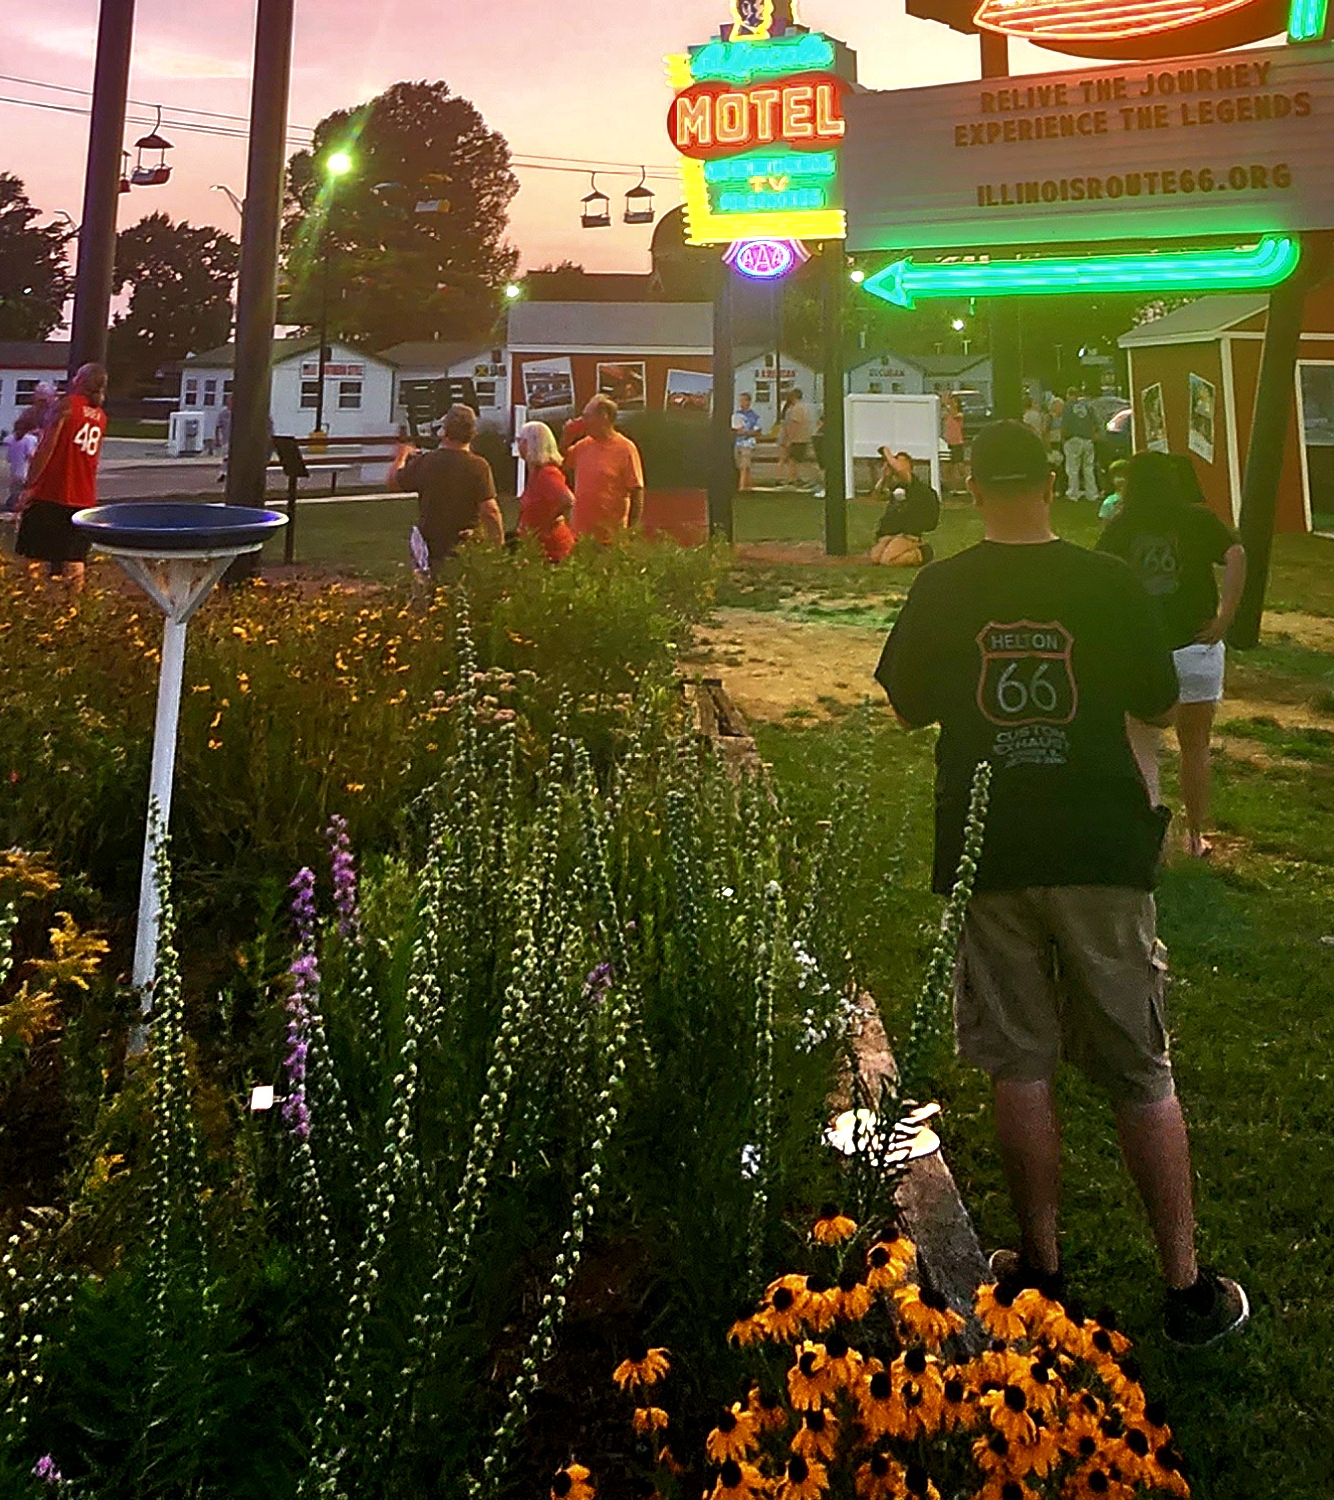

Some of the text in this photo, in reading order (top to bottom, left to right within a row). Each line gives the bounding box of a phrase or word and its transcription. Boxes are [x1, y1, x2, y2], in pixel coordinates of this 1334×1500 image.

[980, 61, 1272, 113] RELIVE THE JOURNEY
[676, 84, 845, 147] MOTEL
[954, 91, 1312, 148] EXPERIENCE THE LEGENDS
[750, 176, 789, 192] TV
[977, 162, 1292, 207] ILLINOISROUTE66.ORG
[741, 243, 784, 272] AAA
[73, 422, 101, 456] 48
[997, 662, 1057, 713] 66
